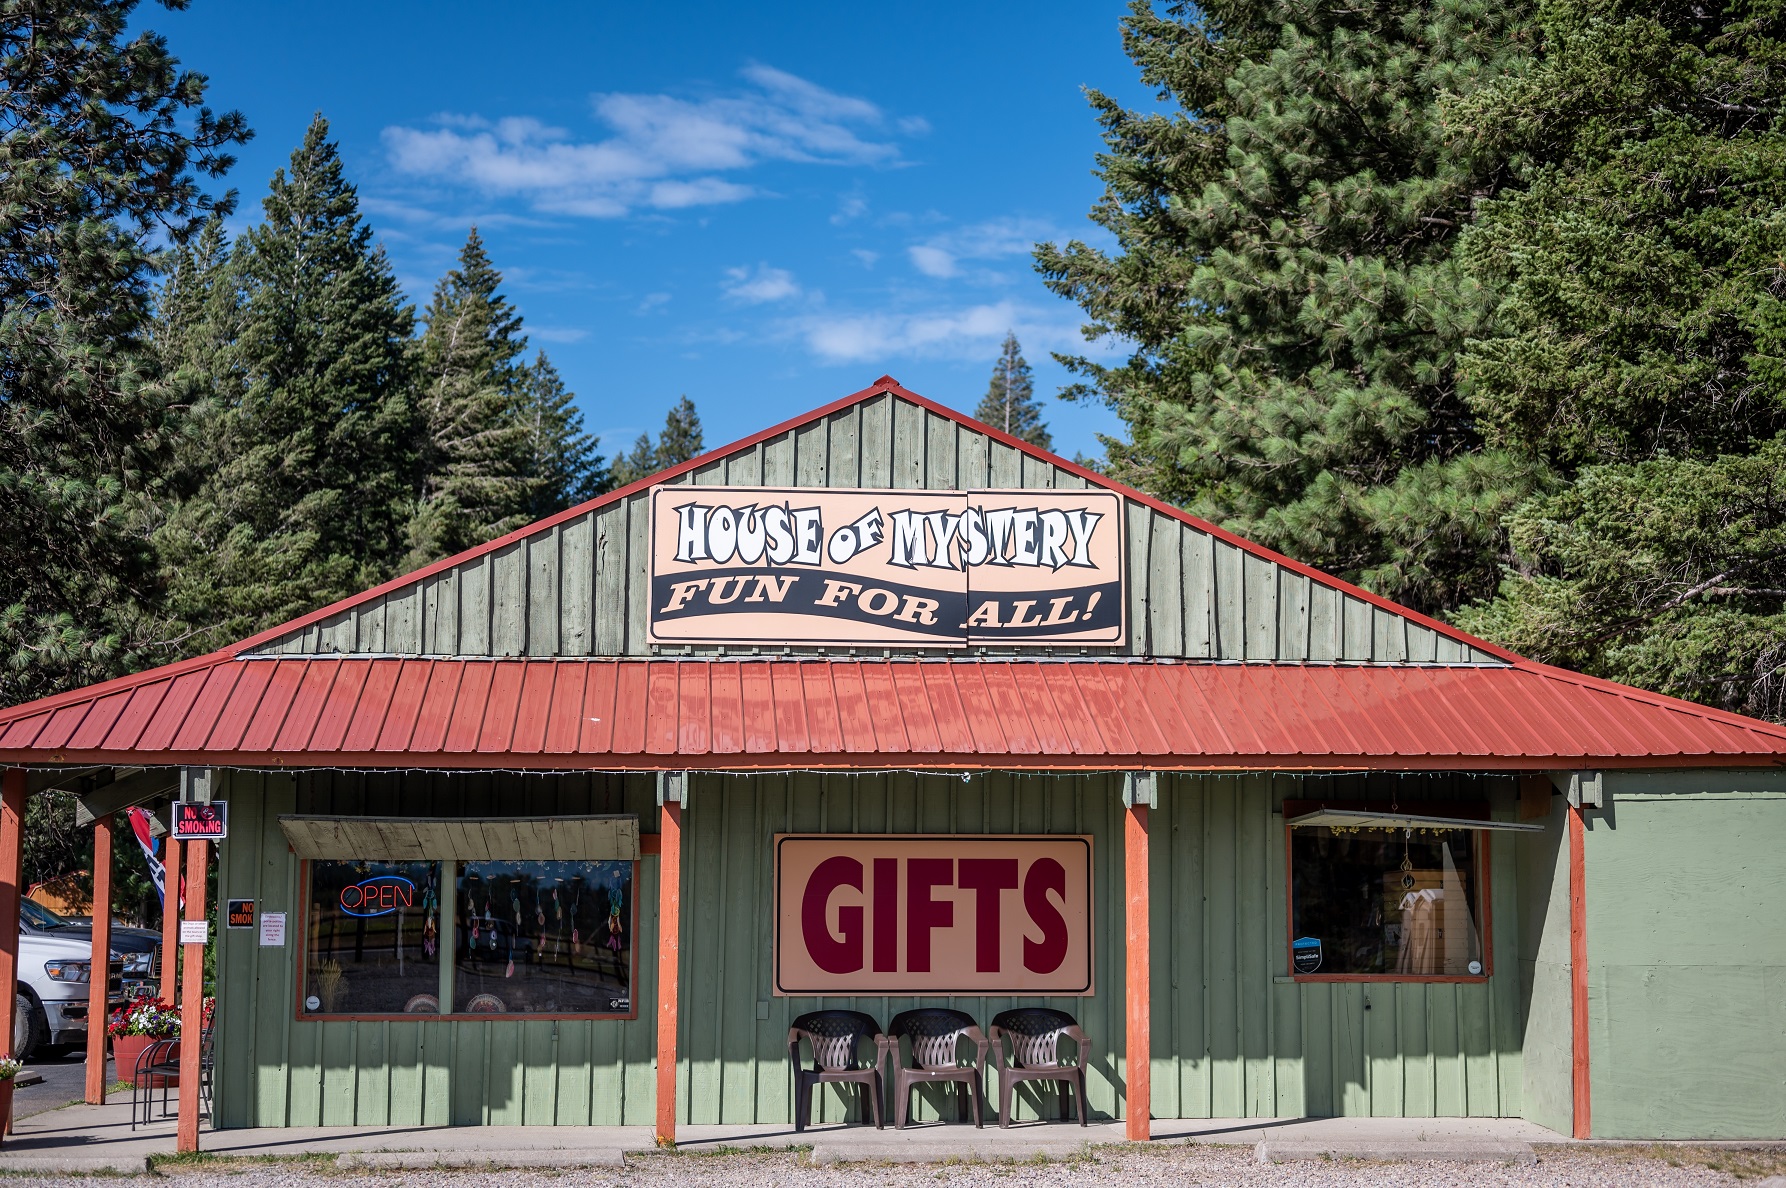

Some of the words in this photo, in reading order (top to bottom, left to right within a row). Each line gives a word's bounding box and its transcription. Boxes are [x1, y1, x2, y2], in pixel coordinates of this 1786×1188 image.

[672, 500, 824, 567] HOUSE
[887, 504, 1106, 572] MYSTERY
[659, 575, 801, 614] FUN
[814, 578, 940, 626] FOR
[960, 591, 1103, 629] ALL!
[184, 806, 198, 820] NO
[179, 820, 221, 834] SMOKING
[242, 902, 254, 913] NO
[340, 884, 413, 909] OPEN
[801, 855, 1068, 975] GIFTS
